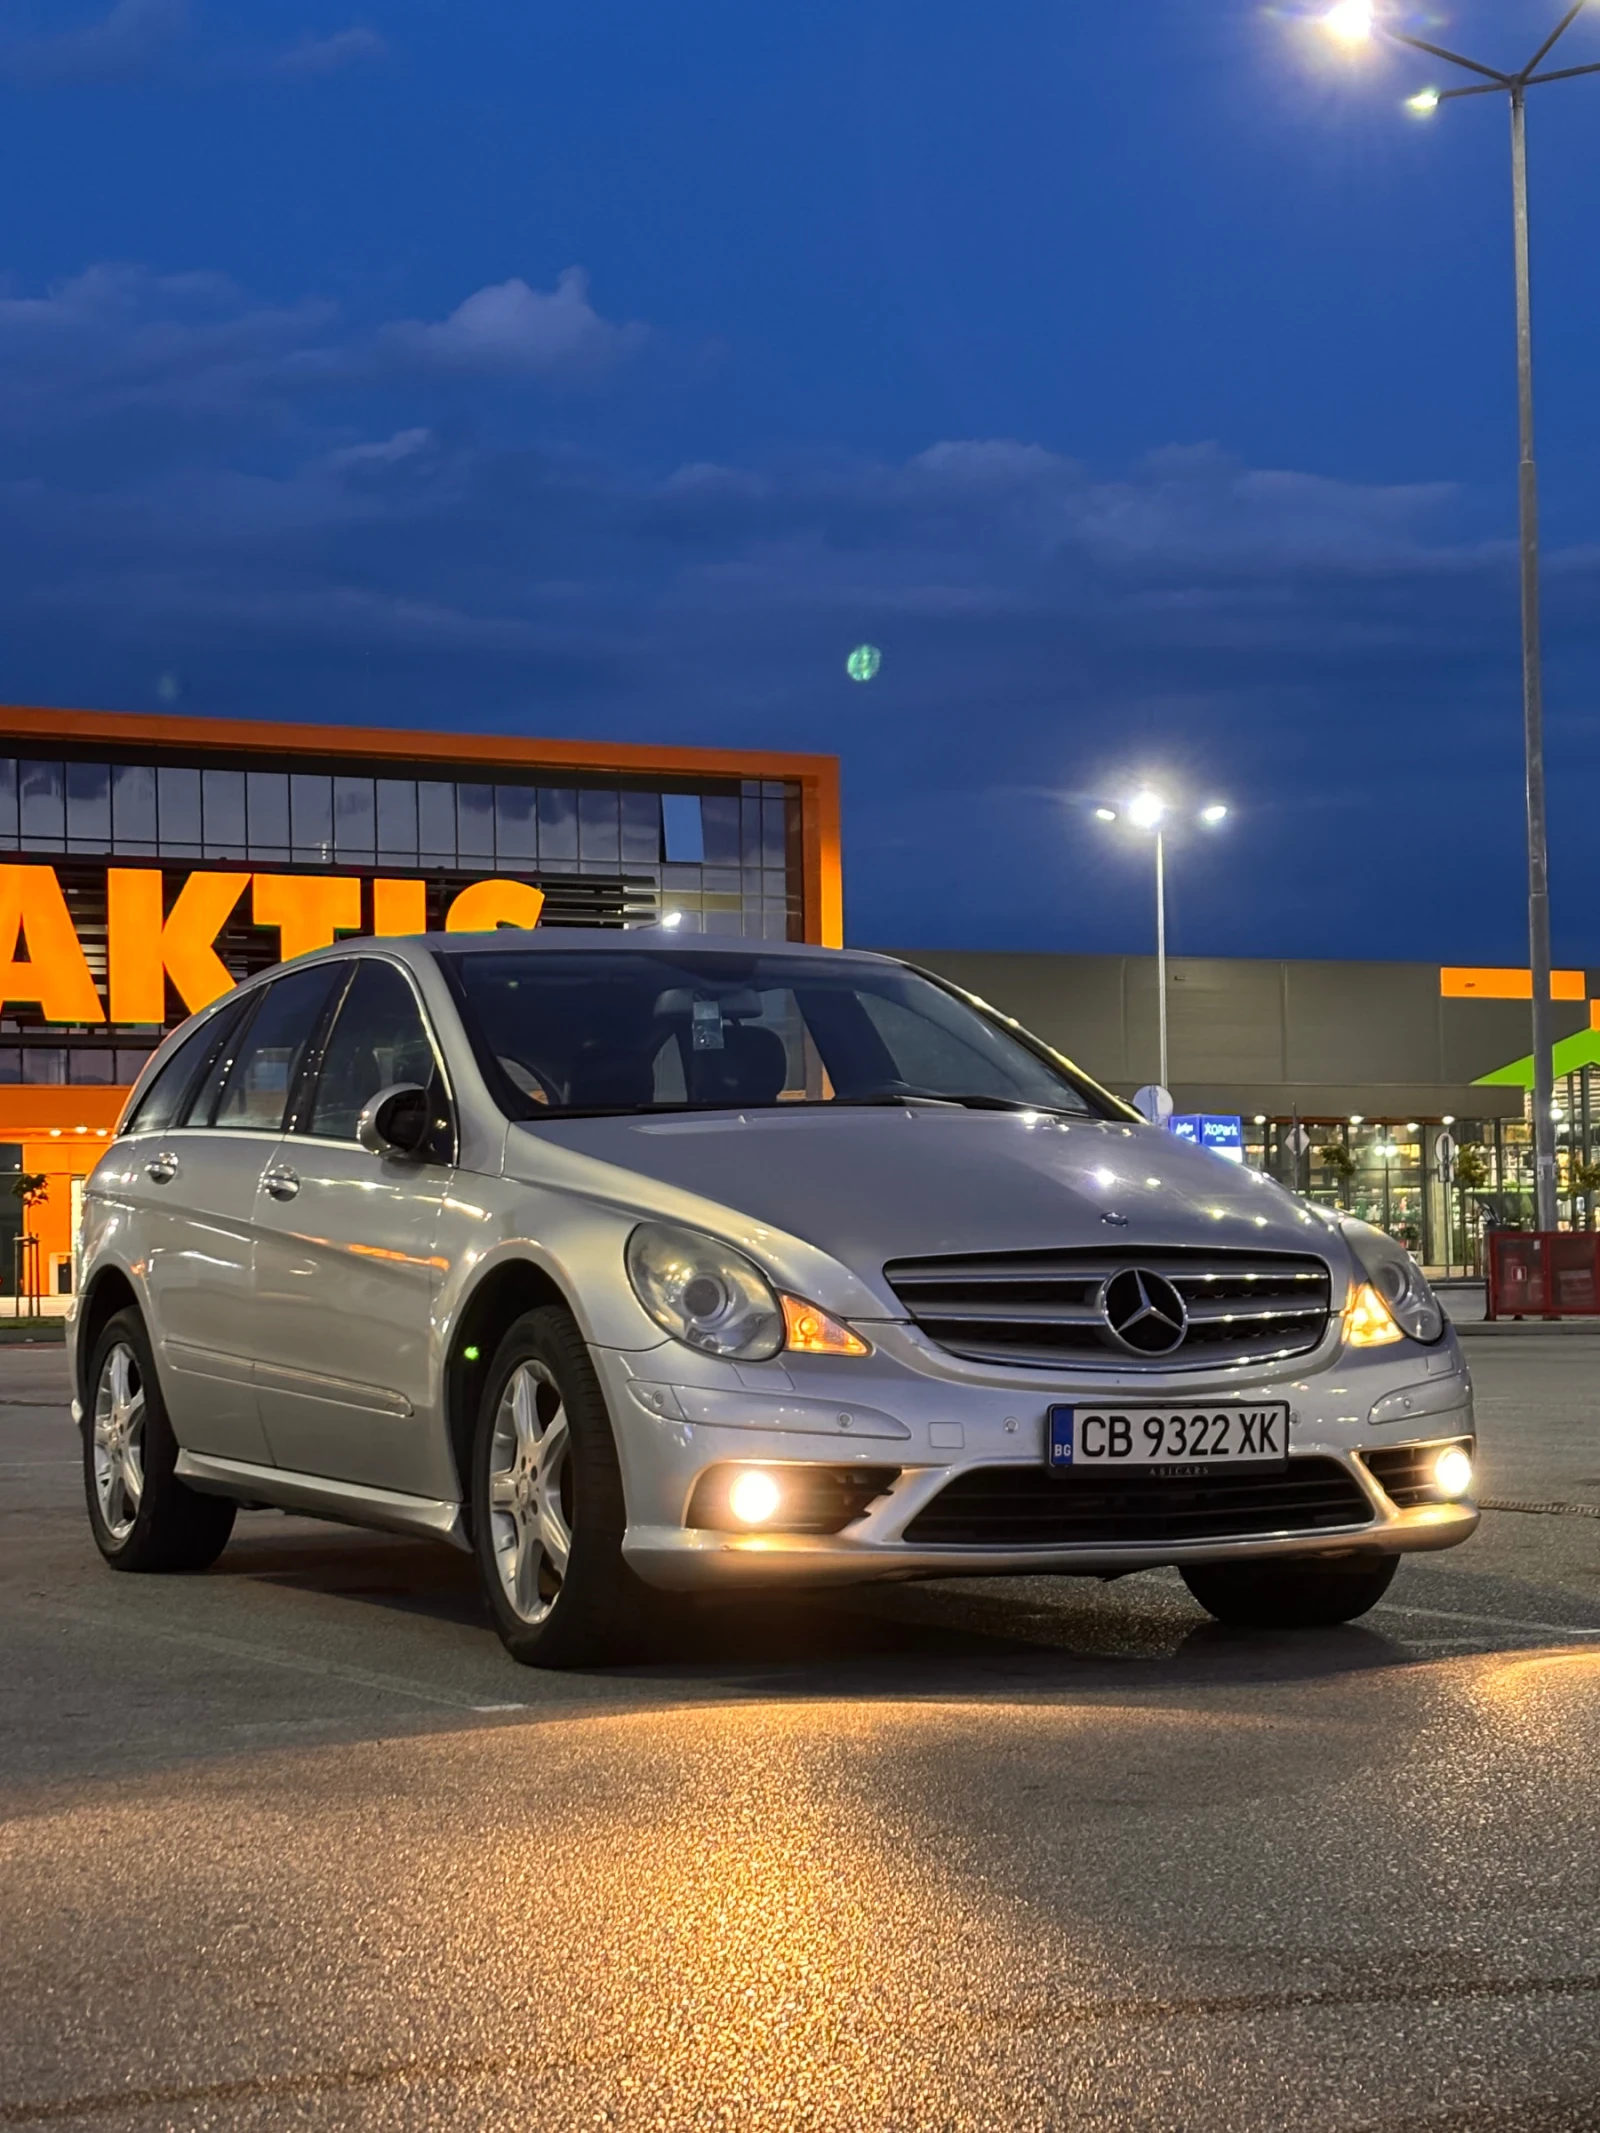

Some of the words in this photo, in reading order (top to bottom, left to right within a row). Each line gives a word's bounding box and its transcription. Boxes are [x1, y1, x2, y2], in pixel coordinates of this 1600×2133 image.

[1081, 1415, 1133, 1457] CB
[1143, 1413, 1231, 1457] 9322
[1237, 1412, 1279, 1453] XK
[1054, 1444, 1071, 1456] BG
